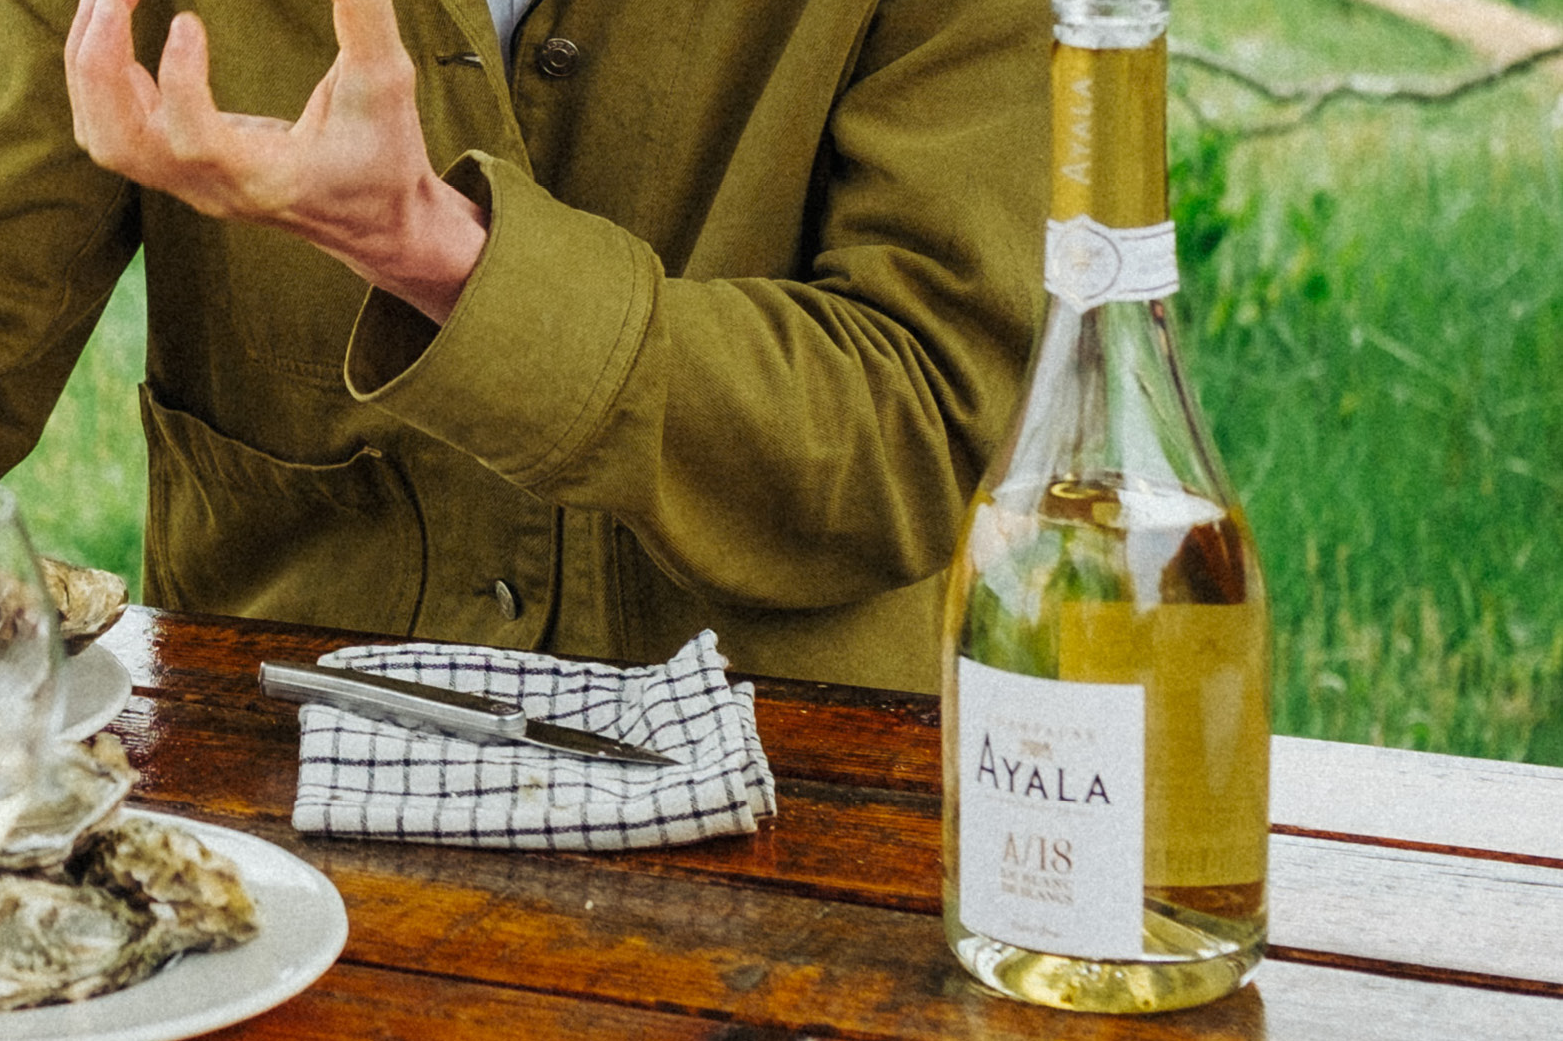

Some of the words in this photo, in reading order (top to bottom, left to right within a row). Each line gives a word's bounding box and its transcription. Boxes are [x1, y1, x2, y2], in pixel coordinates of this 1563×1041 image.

[1060, 78, 1093, 185] AYALA
[977, 731, 1111, 805] AYALA
[1003, 830, 1073, 874] A/18
